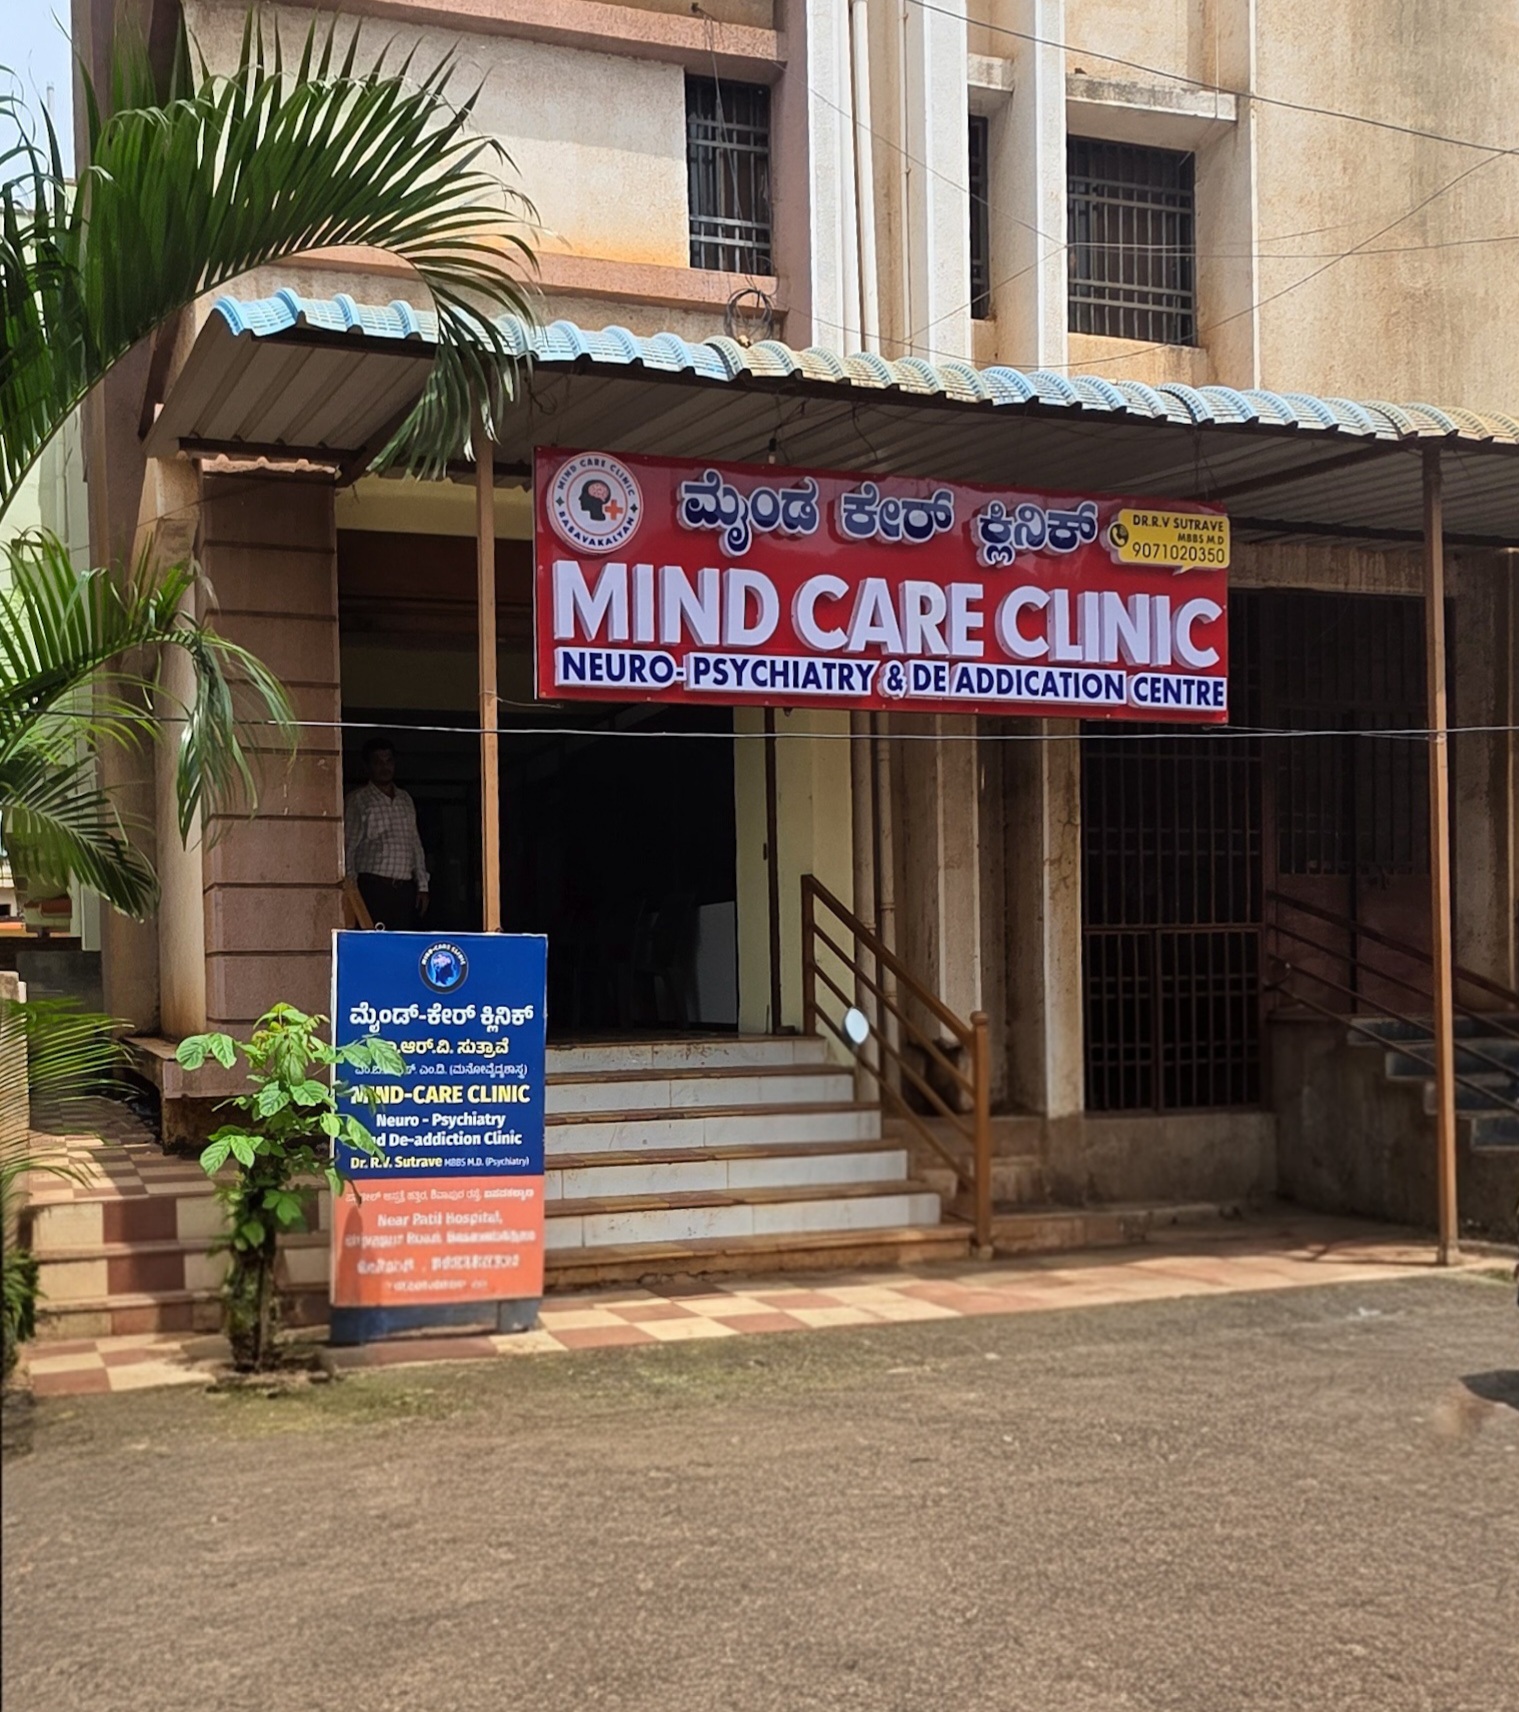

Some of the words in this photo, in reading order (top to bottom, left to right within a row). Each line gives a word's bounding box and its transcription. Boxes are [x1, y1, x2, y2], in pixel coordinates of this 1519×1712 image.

[557, 465, 577, 490] MIND
[579, 458, 606, 468] CARE
[610, 464, 635, 497] CLINIC
[842, 481, 955, 542] ಕೇರ್
[978, 500, 1098, 566] ಕ್ಲಿನಿಕ್
[1173, 517, 1224, 532] SUTRAVE
[1177, 532, 1204, 544] MBBS
[1132, 541, 1225, 563] 9071020350
[553, 560, 779, 648] MIND
[792, 574, 984, 659] CARE
[996, 585, 1223, 669] CLINIC
[886, 664, 904, 692] &
[912, 664, 947, 692] DE
[955, 668, 1125, 701] ADDICATION
[1133, 676, 1225, 707] CENTRE
[480, 1005, 535, 1034] ಕ್ಲಿನಿಕ್
[467, 1084, 531, 1104] CLINIC
[376, 1113, 420, 1128] Neuro
[432, 1111, 506, 1129] Psychiatry
[389, 1130, 481, 1147] De-addiction
[484, 1129, 522, 1146] Clinic
[350, 1157, 368, 1170] Dr.
[394, 1155, 443, 1169] Sutrave
[444, 1157, 466, 1168] MBBS
[467, 1157, 484, 1167] M.D.
[485, 1156, 530, 1168] (Psychiatry)
[377, 1213, 410, 1228] Near
[412, 1211, 443, 1226] Patil
